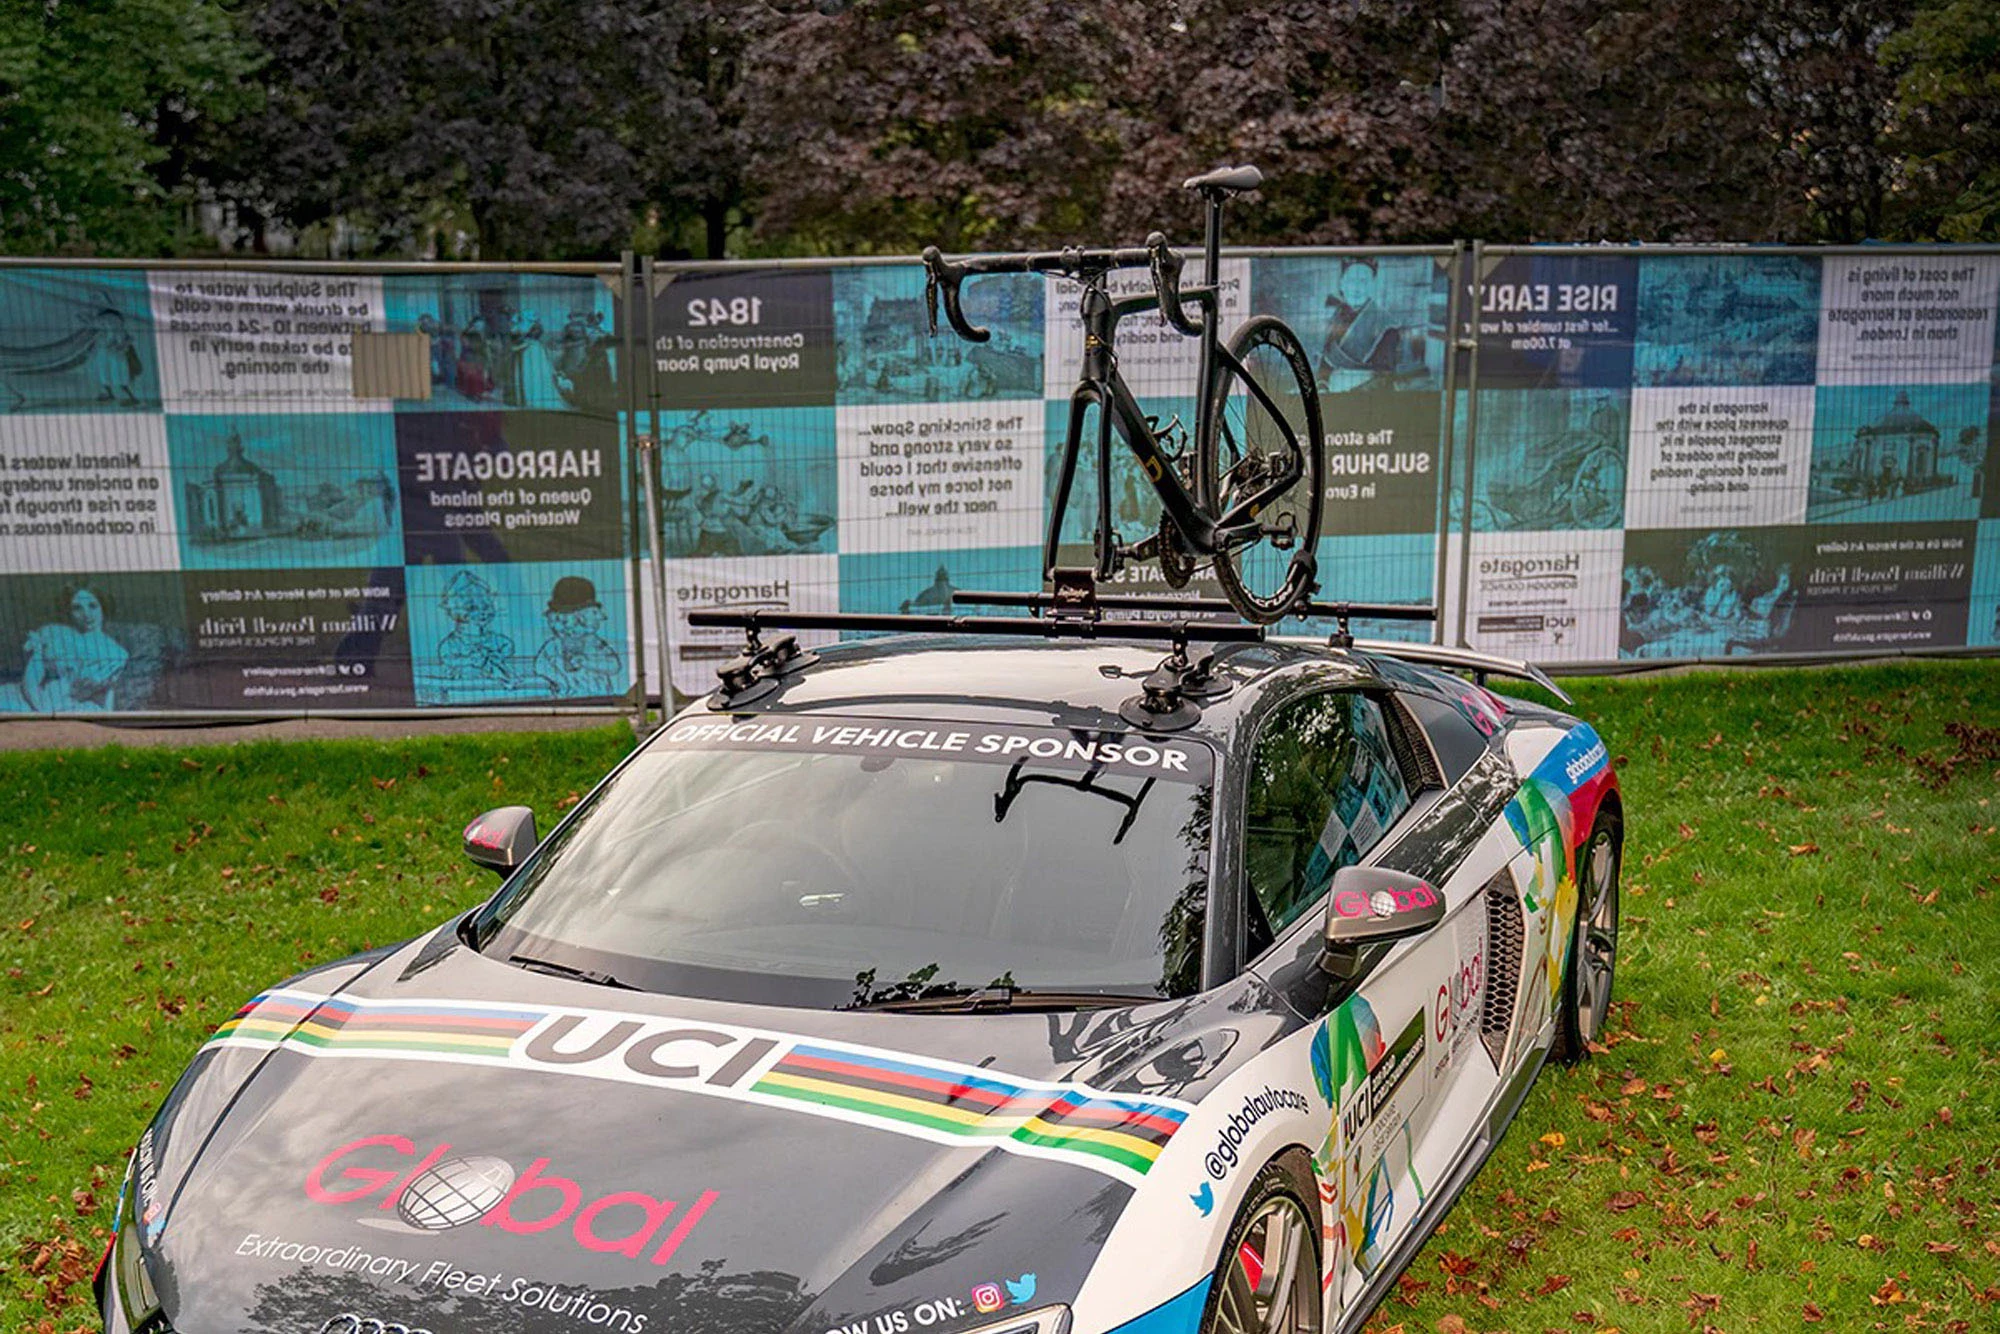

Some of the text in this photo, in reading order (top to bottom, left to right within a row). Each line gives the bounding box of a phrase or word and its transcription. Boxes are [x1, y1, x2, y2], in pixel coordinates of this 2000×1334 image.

[668, 724, 1189, 772] OFFICIAL VEHICLE SPONSOR
[1335, 881, 1438, 918] Global
[525, 1014, 780, 1088] UCI
[1348, 1087, 1371, 1141] UCI
[304, 1134, 720, 1266] Global
[234, 1233, 649, 1333] Extraordinary Fleet Solutions
[875, 1310, 910, 1334] US
[913, 1296, 966, 1326] ON:
